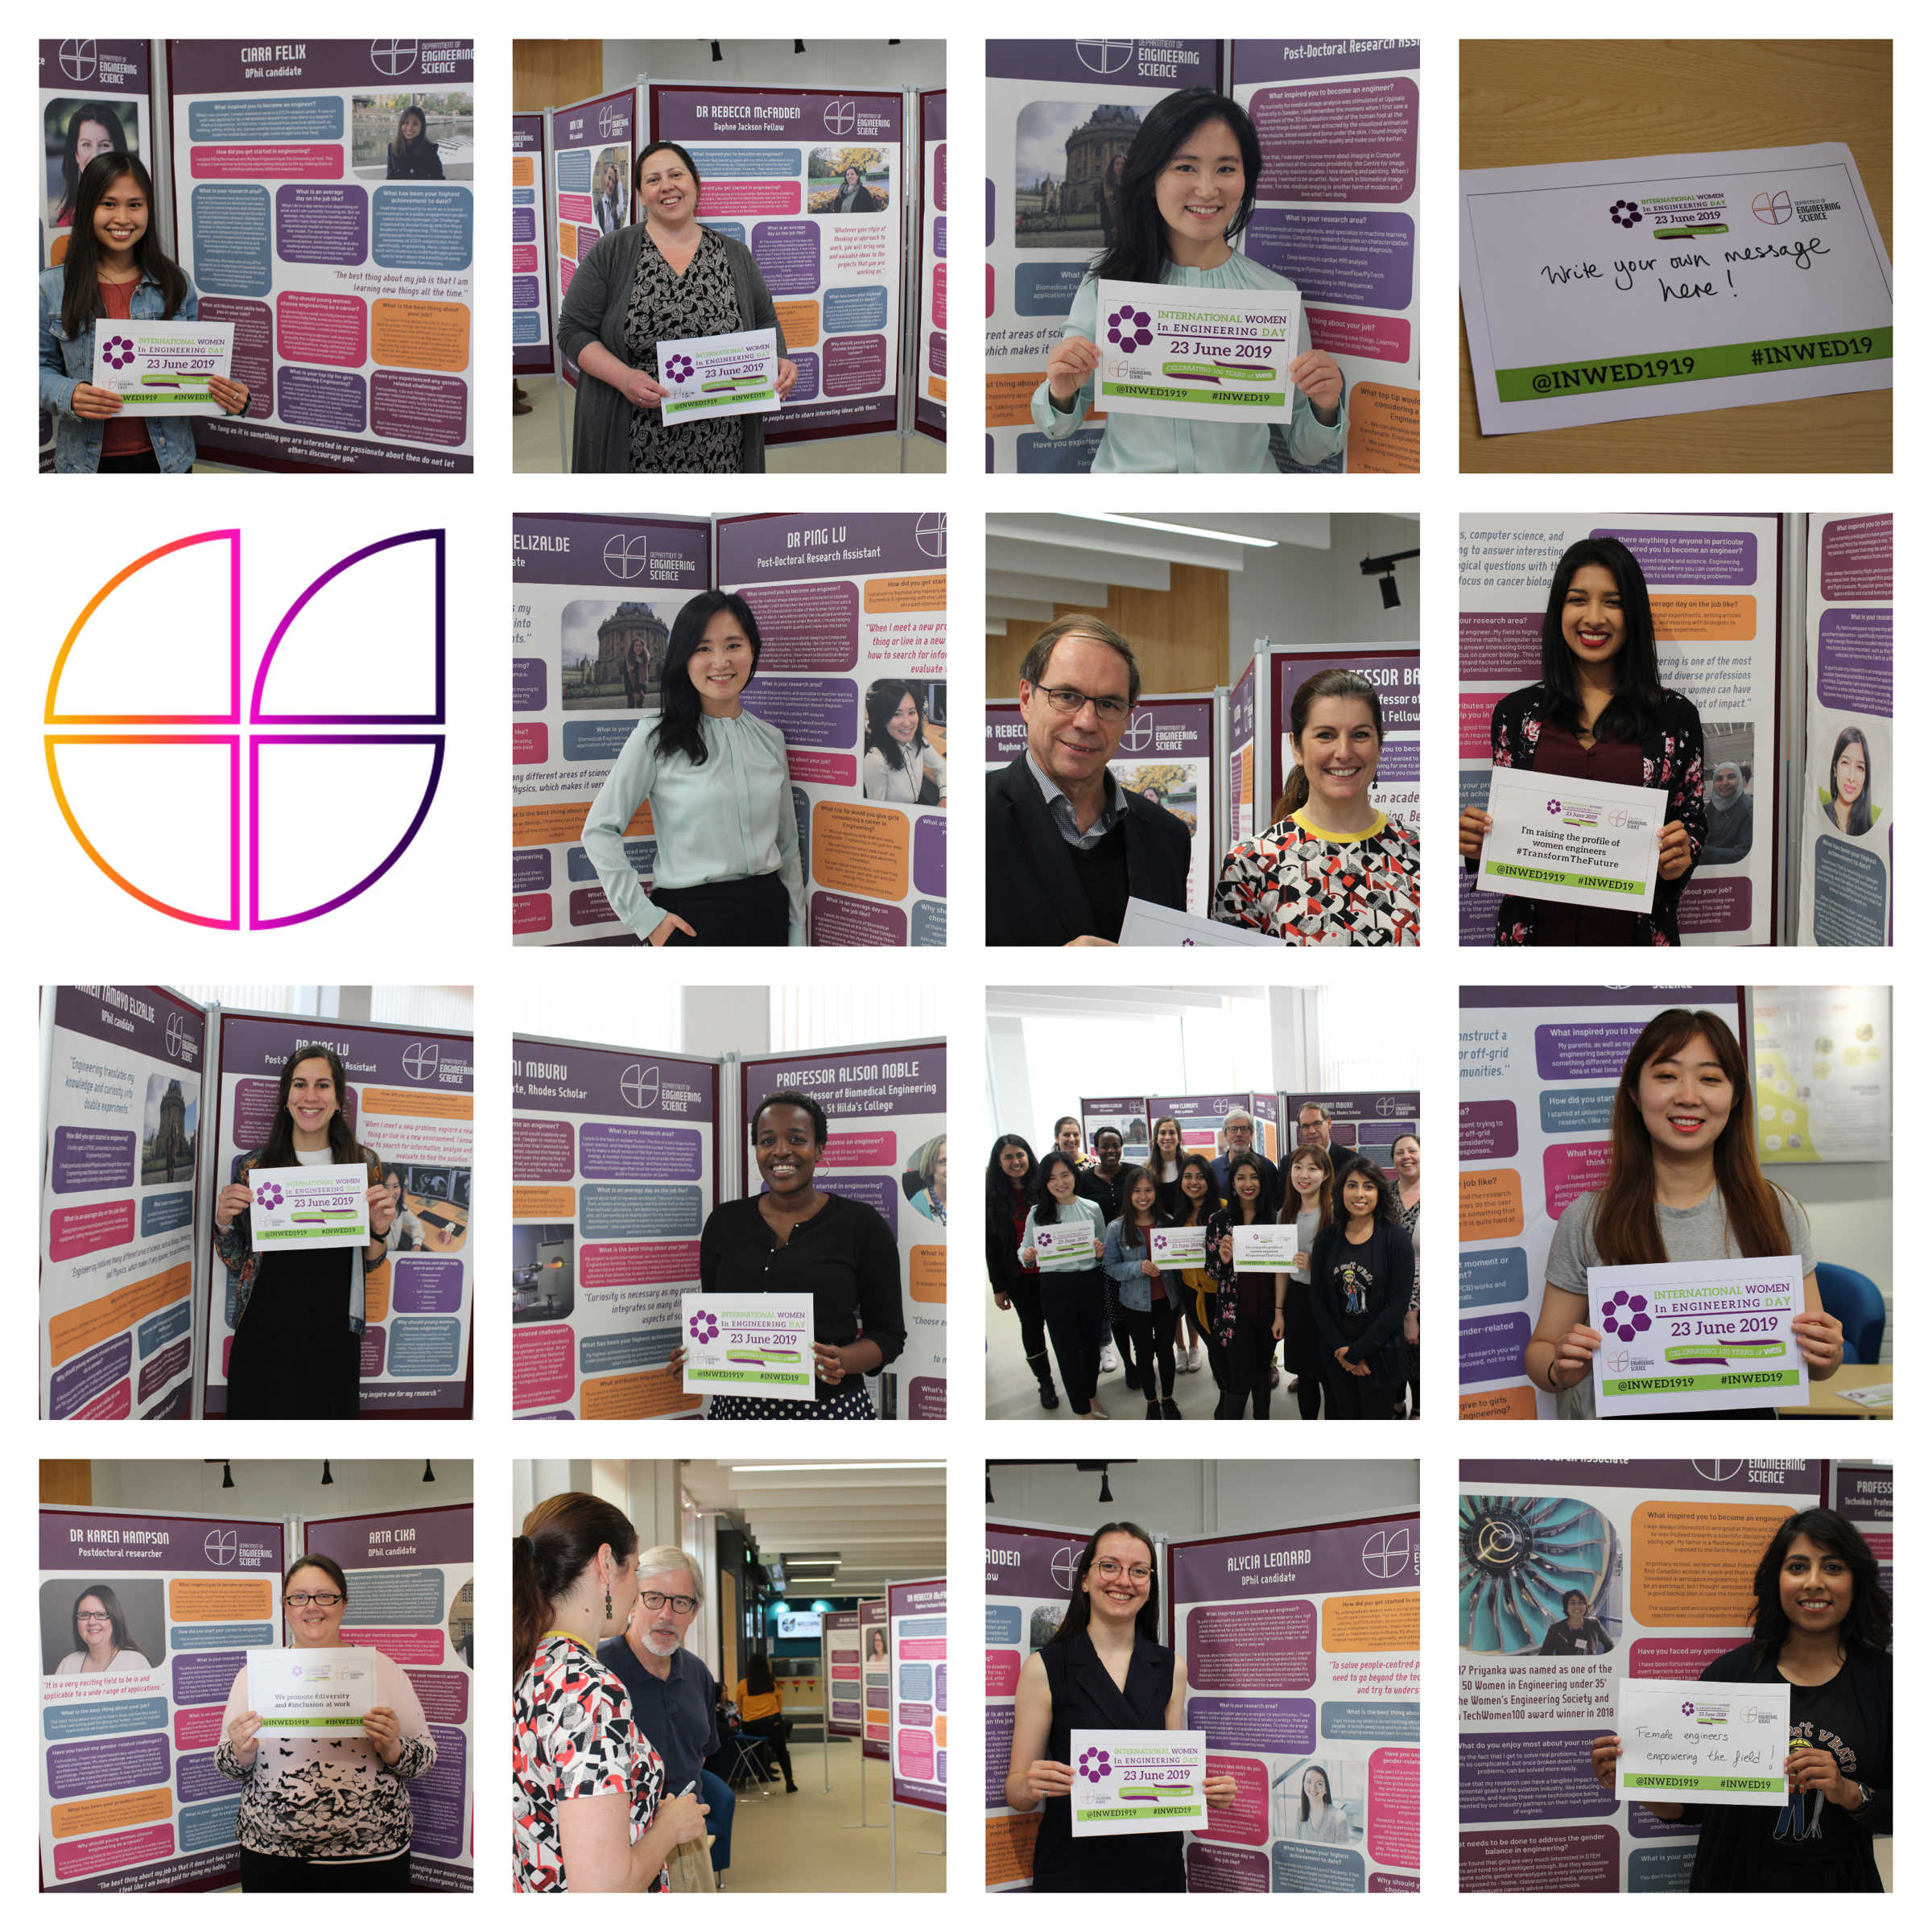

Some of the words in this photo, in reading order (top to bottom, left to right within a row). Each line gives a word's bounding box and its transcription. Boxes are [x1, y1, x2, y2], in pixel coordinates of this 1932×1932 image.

[242, 47, 272, 63] CIARA
[276, 45, 306, 61] FELIX
[1138, 49, 1199, 64] ENGINEERING
[1284, 45, 1346, 60] Post-Doctoral
[246, 66, 263, 78] DPhil
[266, 65, 302, 77] candidate
[1138, 63, 1177, 78] SCIENCE
[696, 106, 709, 118] DR
[712, 106, 751, 118] REBECCA
[754, 106, 800, 119] McFADDEN
[714, 122, 735, 132] Daphne
[737, 122, 762, 131] Jackson
[763, 122, 784, 131] Fellow
[1655, 215, 1669, 225] 23
[1670, 213, 1694, 224] June
[1698, 210, 1721, 221] 2019
[1541, 261, 1604, 285] Write
[1614, 257, 1657, 290] your
[1670, 254, 1710, 269] own
[1724, 237, 1831, 269] message
[1660, 278, 1718, 302] here
[1729, 270, 1737, 297] !
[1158, 311, 1243, 322] INTERNATIONAL
[1245, 315, 1287, 324] WOMEN
[1157, 323, 1172, 332] In
[1174, 324, 1257, 336] ENGINEERING
[1262, 328, 1286, 337] DAY
[1170, 341, 1191, 356] 23
[1193, 343, 1232, 358] June
[1235, 345, 1272, 359] 2019
[147, 360, 160, 369] 23
[162, 359, 188, 369] June
[190, 360, 215, 369] 2019
[1533, 357, 1695, 393] @INWED1919
[1752, 336, 1873, 366] #INWED19
[732, 392, 766, 401] #INWED19
[1117, 385, 1187, 398] @INWED1919
[1212, 391, 1270, 402] #INWED19
[787, 533, 800, 548] DR
[803, 529, 828, 547] PING
[832, 526, 846, 544] LU
[1470, 531, 1511, 542] computer
[1513, 531, 1546, 541] science,
[1549, 531, 1564, 540] and
[758, 554, 805, 568] Post-Doctoral
[807, 550, 840, 564] Research
[843, 547, 881, 560] Assistant
[1472, 545, 1480, 554] to
[1483, 547, 1514, 555] answer
[1516, 547, 1564, 559] interesting
[1484, 561, 1525, 572] questions
[1529, 562, 1547, 571] with
[1484, 577, 1493, 585] on
[1496, 577, 1525, 586] cancer
[1156, 732, 1198, 741] ENGINEERING
[1156, 741, 1183, 750] SCIENCE
[1521, 826, 1534, 835] I'm
[1536, 829, 1565, 840] raising
[1567, 832, 1580, 841] the
[1582, 835, 1610, 845] profile
[1612, 839, 1620, 847] of
[1533, 840, 1563, 850] women
[1566, 844, 1606, 856] engineers
[1517, 848, 1619, 868] #TransformTheFuture
[1496, 865, 1565, 882] @INWED1919
[1578, 877, 1634, 891] #INWED19
[130, 997, 155, 1023] ELIZALDE
[101, 1009, 114, 1024] DPhil
[114, 1018, 134, 1033] candidate
[1550, 1028, 1571, 1037] What
[1572, 1028, 1604, 1038] inspired
[1606, 1029, 1619, 1038] you
[1620, 1026, 1628, 1034] to
[526, 1062, 568, 1080] MBURU
[777, 1068, 836, 1087] PROFESSOR
[839, 1065, 877, 1082] ALISON
[882, 1061, 919, 1079] NOBLE
[528, 1086, 556, 1096] Rhodes
[559, 1088, 588, 1100] Scholar
[844, 1088, 886, 1097] Biomedical
[889, 1083, 937, 1096] Engineering
[827, 1104, 836, 1113] St
[837, 1103, 862, 1113] Hilda's
[864, 1100, 894, 1113] College
[1654, 1286, 1742, 1300] INTERNATIONAL
[1745, 1283, 1790, 1294] WOMEN
[1655, 1304, 1667, 1313] In
[1672, 1298, 1761, 1312] ENGINEERING
[1765, 1297, 1790, 1307] DAY
[1671, 1322, 1690, 1337] 23
[1695, 1321, 1736, 1335] June
[1740, 1316, 1778, 1332] 2019
[1618, 1377, 1695, 1391] @INWED1919
[1721, 1373, 1783, 1385] #INWED19
[70, 1530, 85, 1543] DR
[87, 1530, 120, 1545] KAREN
[123, 1530, 169, 1546] HAMPSON
[369, 1530, 392, 1544] ARTA
[394, 1528, 415, 1542] CIKA
[78, 1548, 122, 1559] Postdoctoral
[125, 1549, 163, 1559] researcher
[368, 1547, 385, 1557] DPhil
[386, 1546, 416, 1556] candidate
[1228, 1554, 1260, 1572] ALYCIA
[1264, 1549, 1311, 1569] LEONARD
[1241, 1575, 1260, 1587] DPhil
[1261, 1573, 1296, 1584] candidate
[1469, 1666, 1506, 1678] Priyanka
[1530, 1665, 1556, 1674] named
[1571, 1666, 1585, 1674] one
[1588, 1665, 1596, 1673] of
[1599, 1665, 1612, 1673] the
[1463, 1681, 1472, 1690] 50
[1476, 1681, 1505, 1690] Women
[1509, 1681, 1516, 1689] in
[1519, 1680, 1567, 1691] Engineering
[1570, 1679, 1593, 1688] under
[1472, 1695, 1509, 1705] Women's
[1511, 1695, 1560, 1707] Engineering
[1563, 1694, 1592, 1704] Society
[1595, 1694, 1608, 1703] and
[1463, 1710, 1525, 1720] TechWomen100
[1528, 1710, 1554, 1719] award
[1557, 1708, 1585, 1719] winner
[1587, 1708, 1594, 1717] in
[1597, 1707, 1613, 1717] 2018
[1636, 1726, 1674, 1739] Female
[1684, 1732, 1728, 1744] engineers
[1646, 1752, 1698, 1765] empowering
[1707, 1750, 1727, 1761] the
[1732, 1751, 1761, 1767] field
[1637, 1777, 1699, 1787] @INWED1919
[1720, 1779, 1770, 1789] #INWED19
